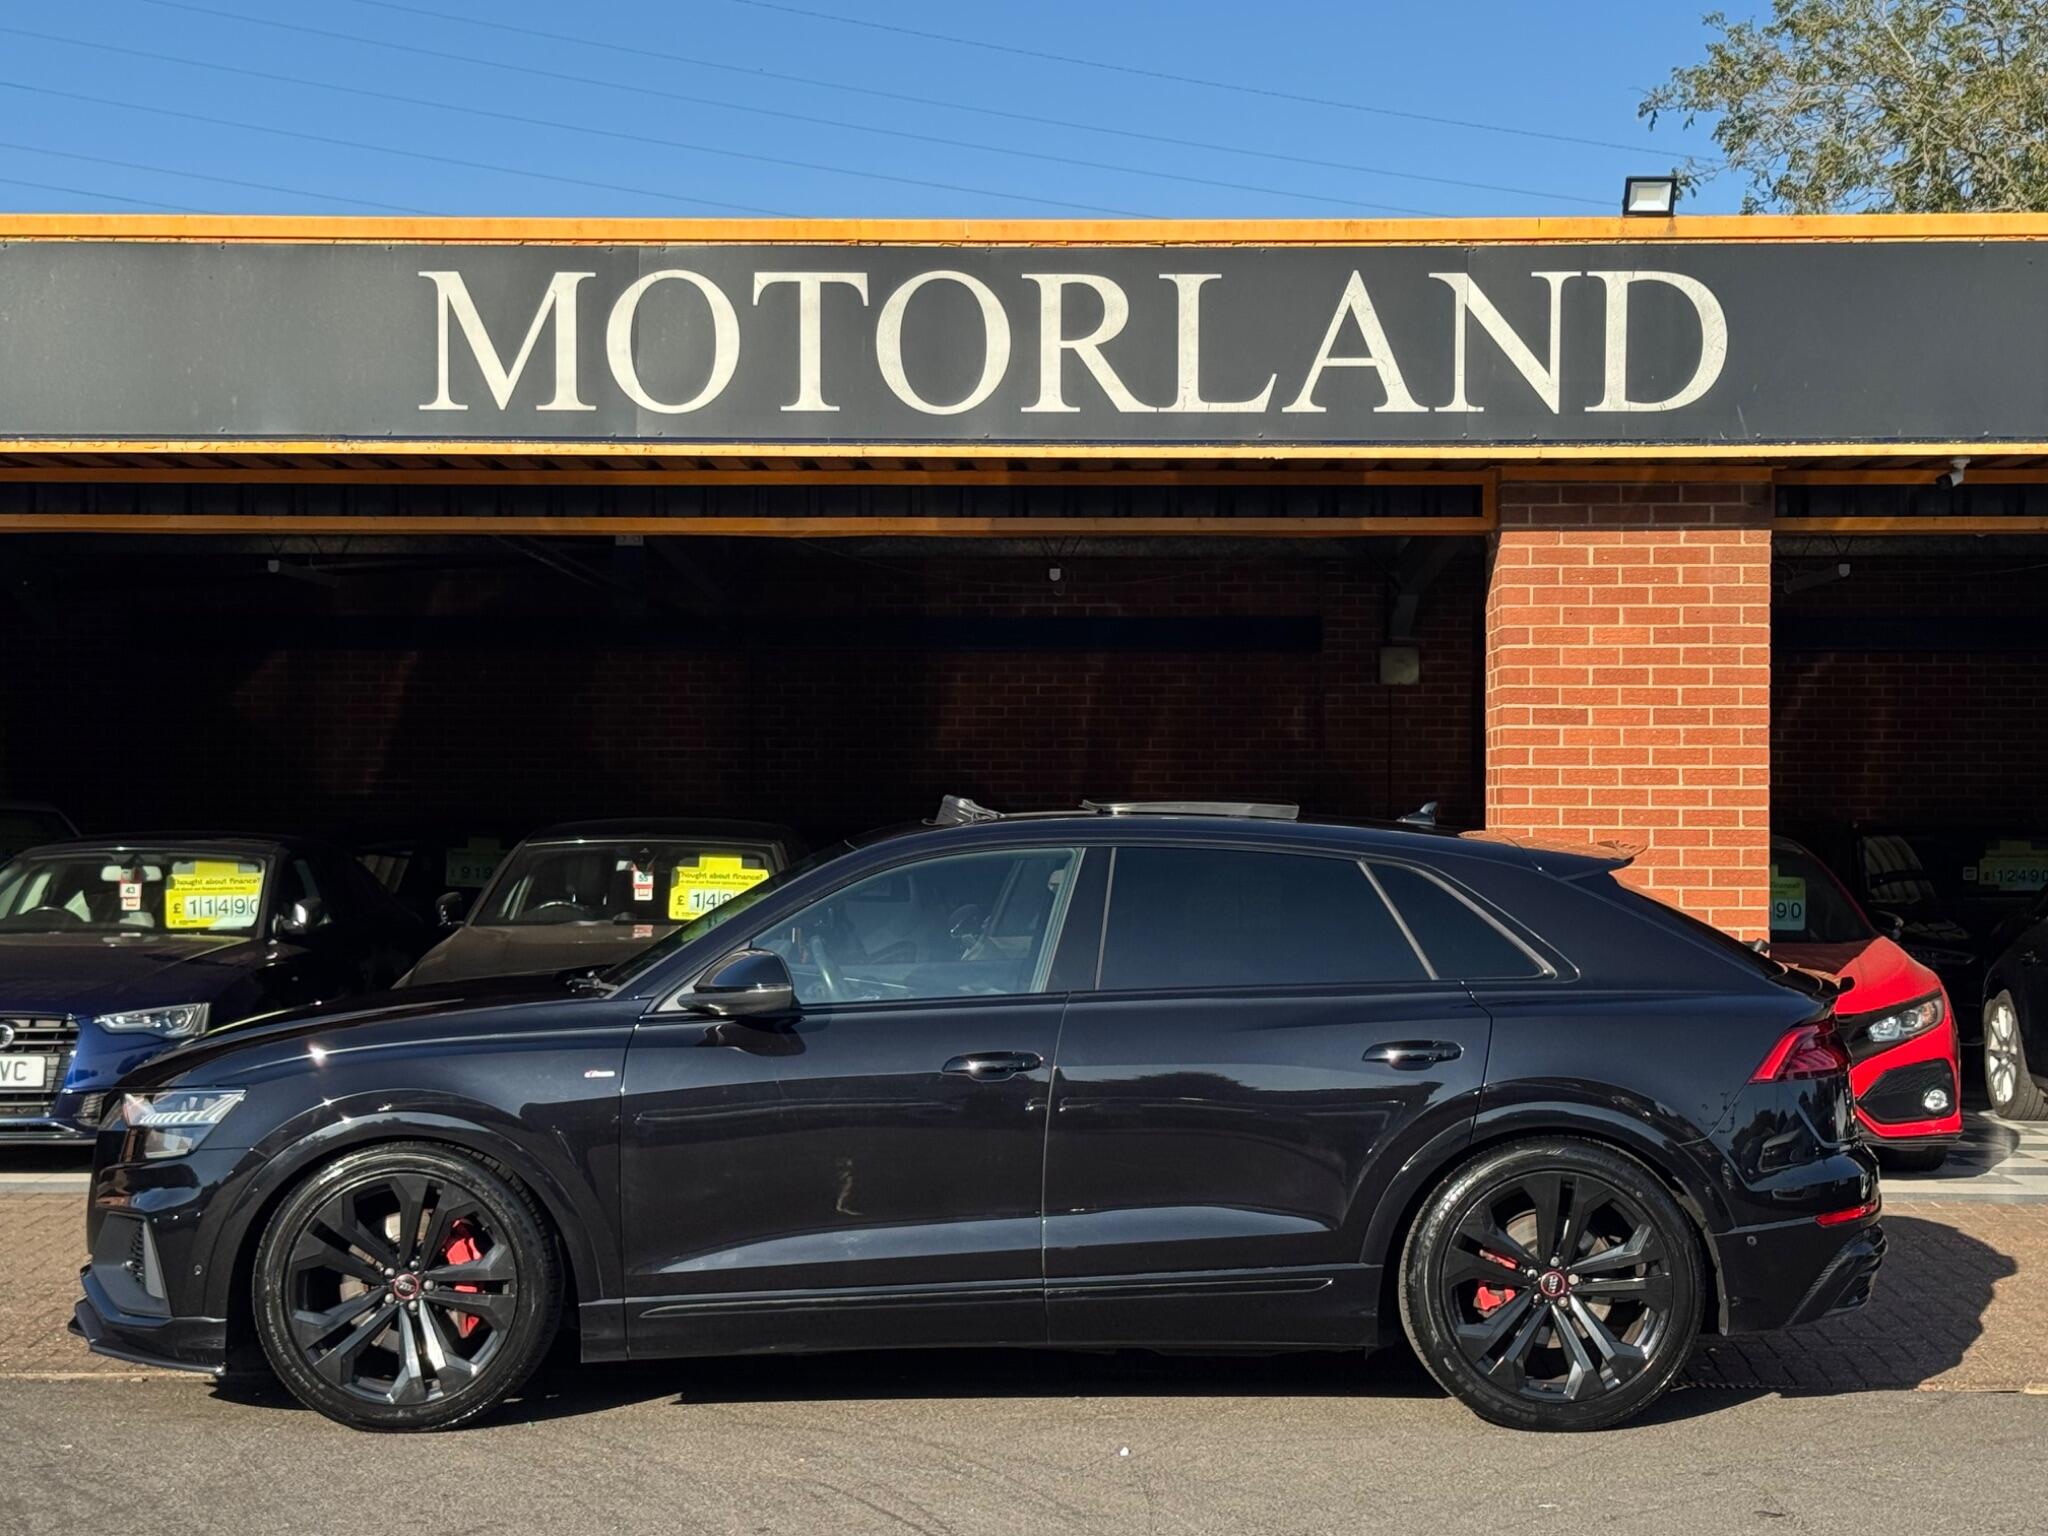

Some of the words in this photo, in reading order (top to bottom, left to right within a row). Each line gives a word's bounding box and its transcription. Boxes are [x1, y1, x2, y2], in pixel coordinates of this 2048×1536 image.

[418, 270, 1728, 415] MOTORLAND
[709, 871, 730, 879] about
[175, 878, 203, 886] hought
[173, 903, 182, 914] £
[188, 898, 259, 915] 11490
[676, 895, 685, 905] £
[0, 1060, 28, 1081] VC
